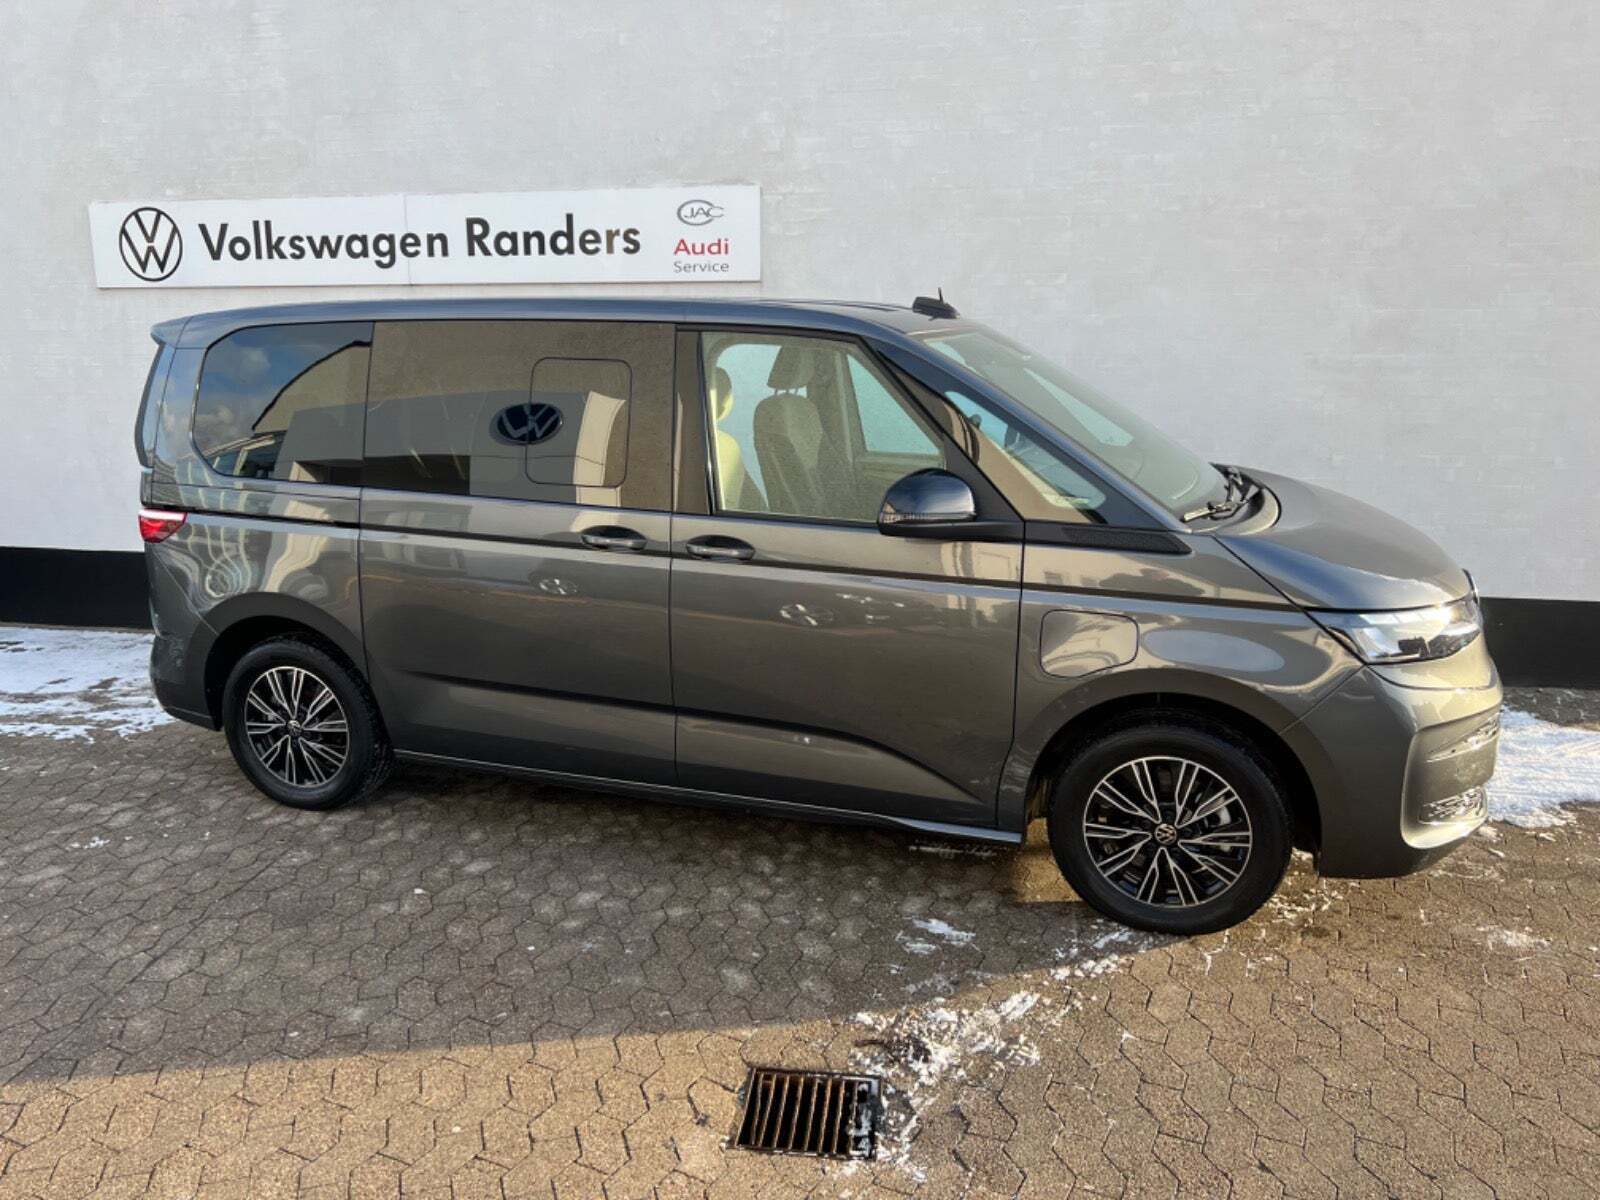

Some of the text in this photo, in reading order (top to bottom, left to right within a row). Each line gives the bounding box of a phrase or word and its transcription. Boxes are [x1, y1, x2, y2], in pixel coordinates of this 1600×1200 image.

[120, 209, 181, 277] VW
[198, 213, 641, 269] Volkswagen Randers
[673, 238, 729, 256] Audi
[673, 260, 730, 273] Service
